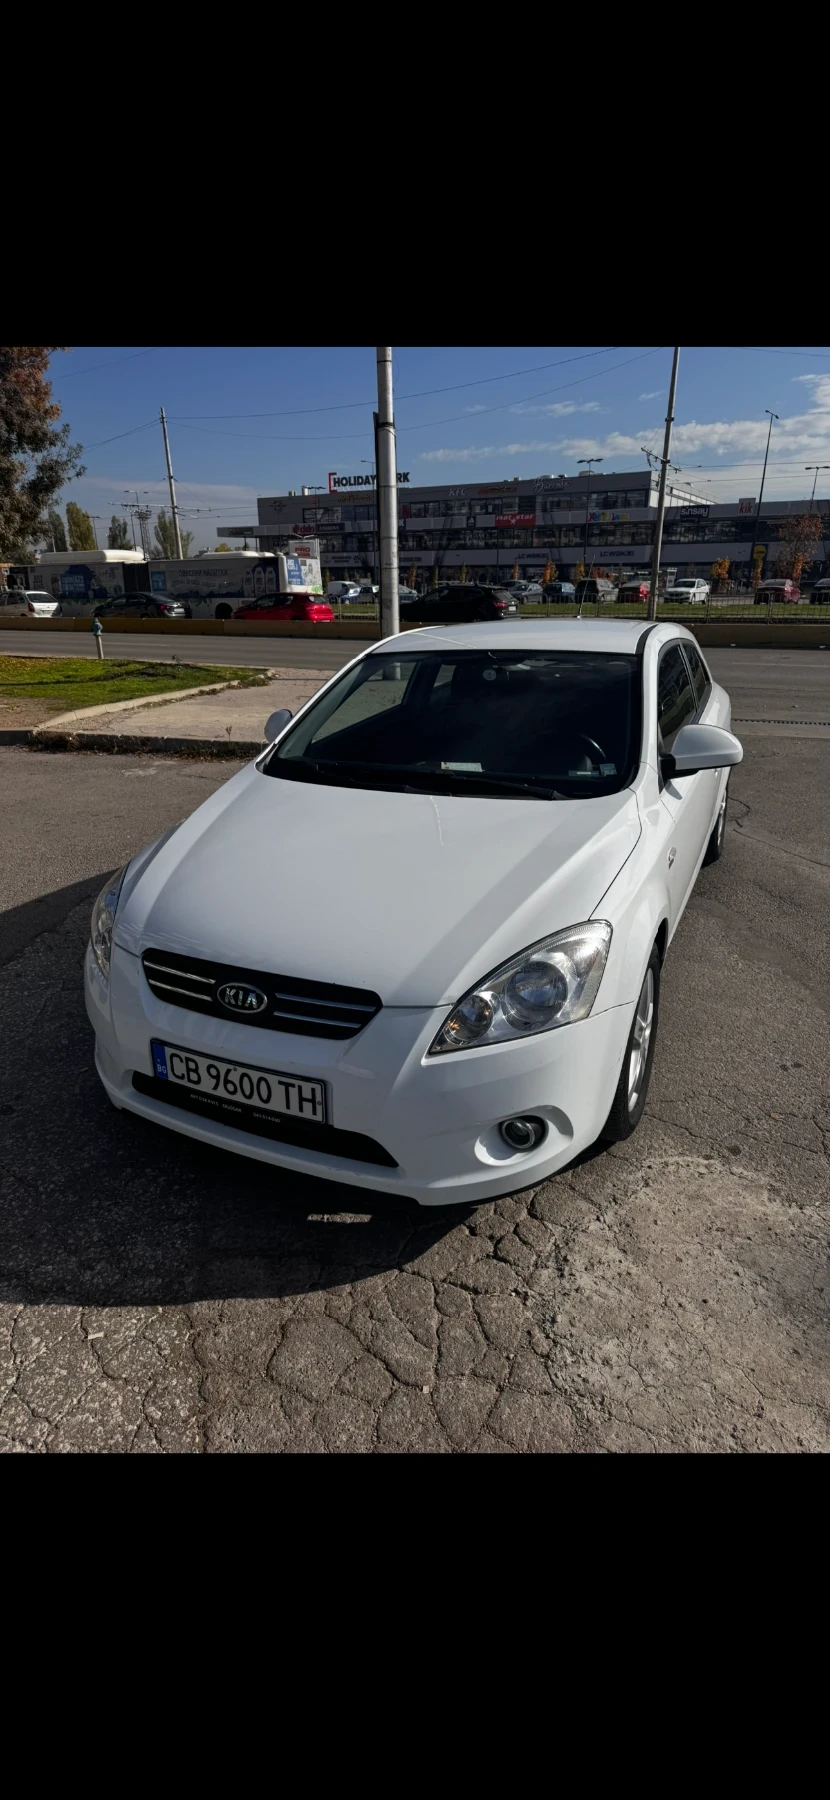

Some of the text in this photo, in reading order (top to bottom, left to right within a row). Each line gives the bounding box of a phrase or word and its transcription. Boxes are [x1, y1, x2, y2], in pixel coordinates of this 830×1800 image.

[333, 472, 410, 487] HOLIDAY RK
[449, 488, 467, 497] KFC
[681, 507, 708, 517] sinsay
[224, 988, 257, 1009] KIA
[157, 1064, 167, 1074] BG
[169, 1052, 318, 1116] CB 9600 TH
